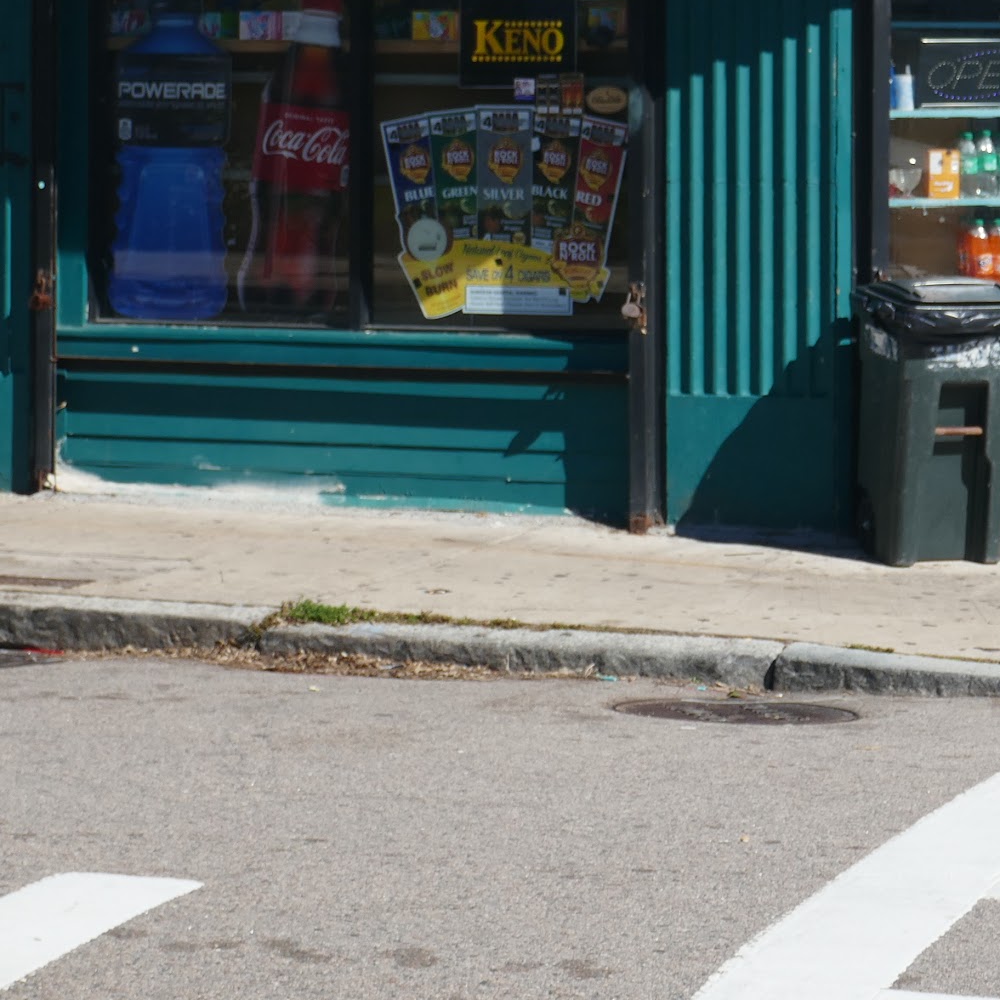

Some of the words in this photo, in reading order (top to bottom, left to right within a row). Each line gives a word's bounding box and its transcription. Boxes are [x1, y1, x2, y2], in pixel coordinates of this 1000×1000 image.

[118, 81, 227, 100] POWERADE
[404, 187, 435, 203] BLUE
[442, 186, 478, 199] GREEN
[483, 188, 525, 201] SILVER
[531, 184, 569, 200] BLACK
[576, 190, 602, 206] RED
[559, 241, 597, 254] ROCK
[420, 260, 454, 281] SLOW
[466, 268, 490, 282] SAVE
[504, 265, 514, 282] 4
[517, 269, 551, 283] CIGARS
[424, 278, 458, 297] BURN
